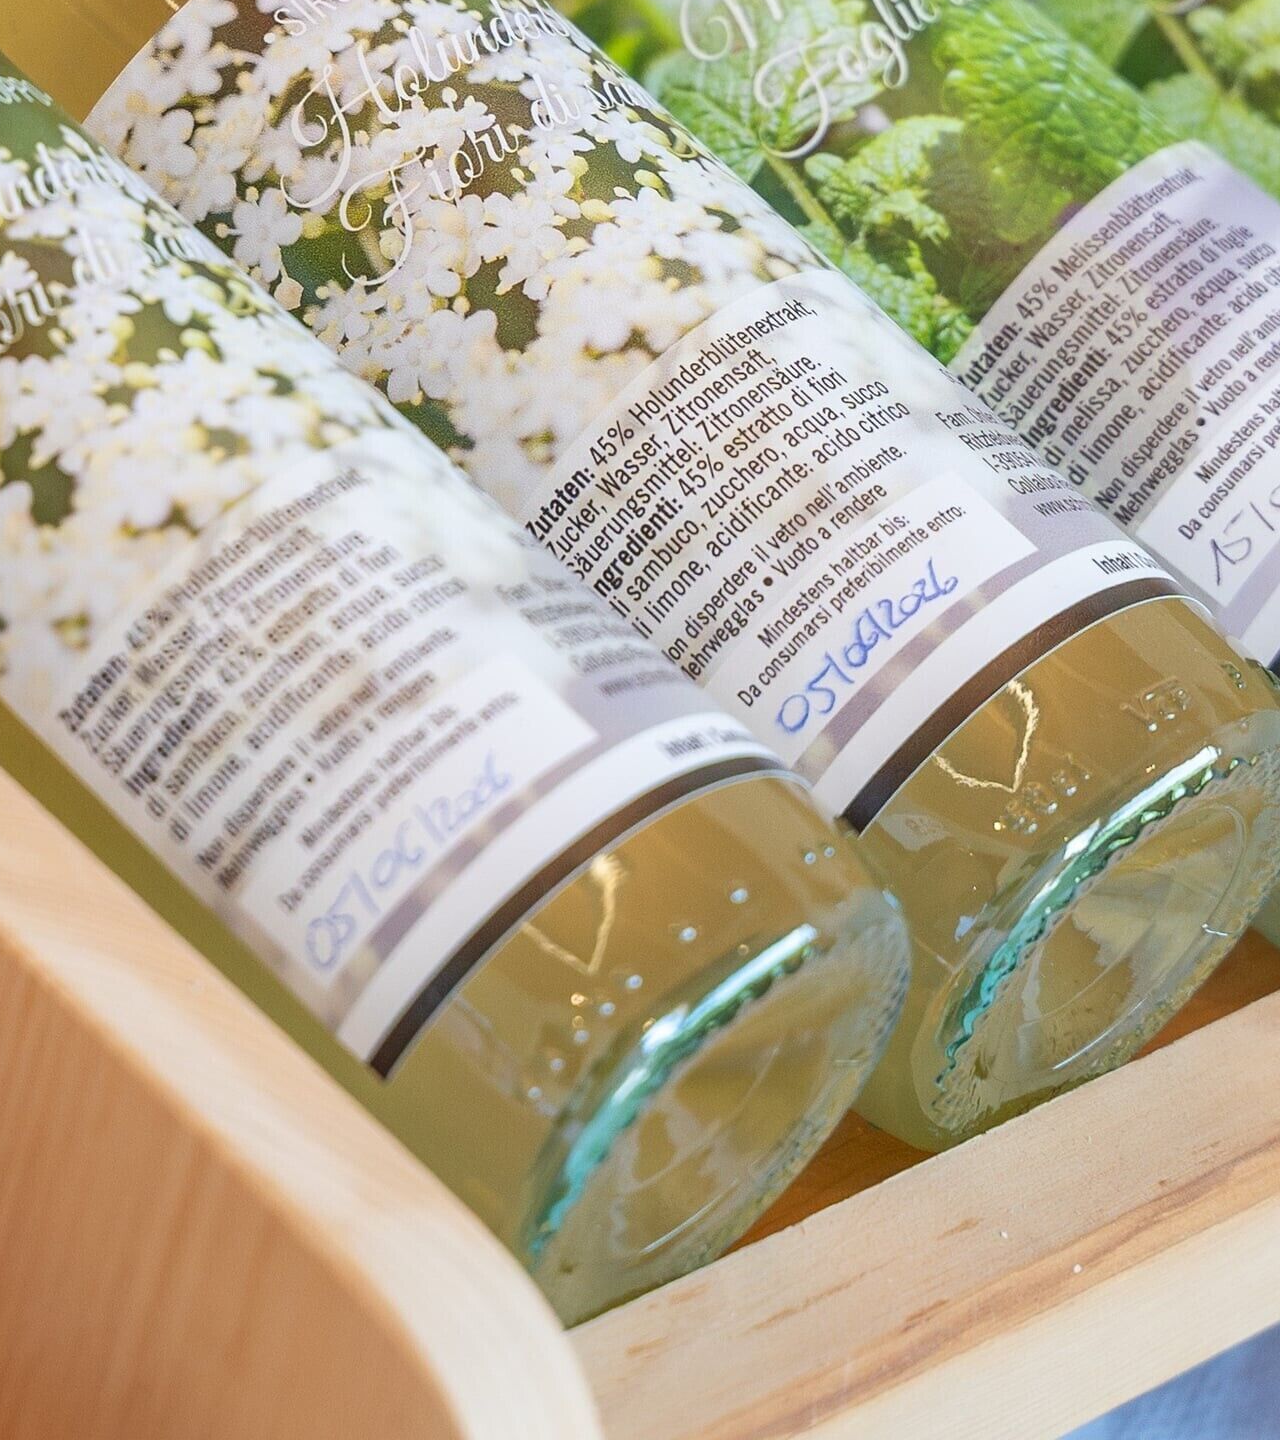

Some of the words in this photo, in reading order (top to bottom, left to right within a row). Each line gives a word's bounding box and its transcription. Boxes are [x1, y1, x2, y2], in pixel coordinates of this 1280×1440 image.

[957, 320, 1023, 392] Zutaten:
[1016, 276, 1059, 321] 45%
[977, 350, 1038, 411] Zucker,
[1025, 289, 1094, 350] Wasser,
[1081, 211, 1182, 293] Zitronensaft,
[997, 292, 1127, 431] Säuerungsmittel:
[1116, 216, 1220, 297] Zitronensäure.
[1019, 344, 1112, 450] Ingredienti:
[1104, 305, 1148, 347] 45%
[1145, 257, 1205, 310] estratto
[1201, 244, 1221, 265] di
[1043, 444, 1066, 468] di
[1061, 376, 1130, 447] melissa,
[1120, 306, 1197, 375] zucchero,
[1190, 266, 1244, 308] acqua,
[1068, 460, 1090, 487] di
[1079, 404, 1146, 467] limone,
[1138, 309, 1233, 402] acidificante:
[1227, 282, 1269, 315] acido
[525, 467, 596, 542] Zutaten:
[588, 420, 635, 468] 45%
[628, 298, 818, 427] Holunderblütenextrakt,
[545, 498, 609, 561] Zucker,
[595, 433, 670, 499] Wasser,
[660, 347, 779, 437] Zitronensaft,
[566, 436, 704, 581] Säuerungsmittel:
[695, 353, 823, 442] Zitronensäure.
[593, 496, 684, 598] ngredienti:
[677, 452, 725, 498] 45%
[723, 406, 794, 459] estratto
[791, 379, 814, 408] di
[806, 367, 849, 396] fiori
[626, 518, 708, 601] sambuco,
[700, 445, 788, 519] zucchero,
[782, 406, 847, 448] acqua,
[840, 380, 890, 410] succo
[643, 558, 712, 624] limone,
[705, 459, 815, 558] acidificante:
[811, 424, 862, 465] acido
[858, 401, 911, 434] citrico
[1093, 475, 1127, 510] Non
[1124, 401, 1190, 479] disperdere
[1182, 388, 1201, 408] il
[1196, 359, 1232, 393] vetro
[1112, 426, 1200, 527] Mehrwegglas
[1202, 380, 1247, 418] Vuoto
[1242, 369, 1258, 384] a
[1177, 516, 1203, 541] Da
[1198, 443, 1266, 521] consumarsi
[1192, 409, 1266, 485] Mindestens
[684, 561, 758, 636] disperdere
[751, 543, 770, 564] il
[765, 512, 808, 551] vetro
[736, 682, 763, 707] Da
[757, 605, 834, 687] consumarsi
[829, 530, 929, 614] preferibilmente
[926, 506, 967, 538] entro:
[756, 571, 836, 649] Mindestens
[832, 534, 884, 578] haltbar
[880, 514, 911, 539] bis:
[770, 537, 819, 578] Vuoto
[817, 525, 832, 541] a
[830, 482, 889, 530] rendere
